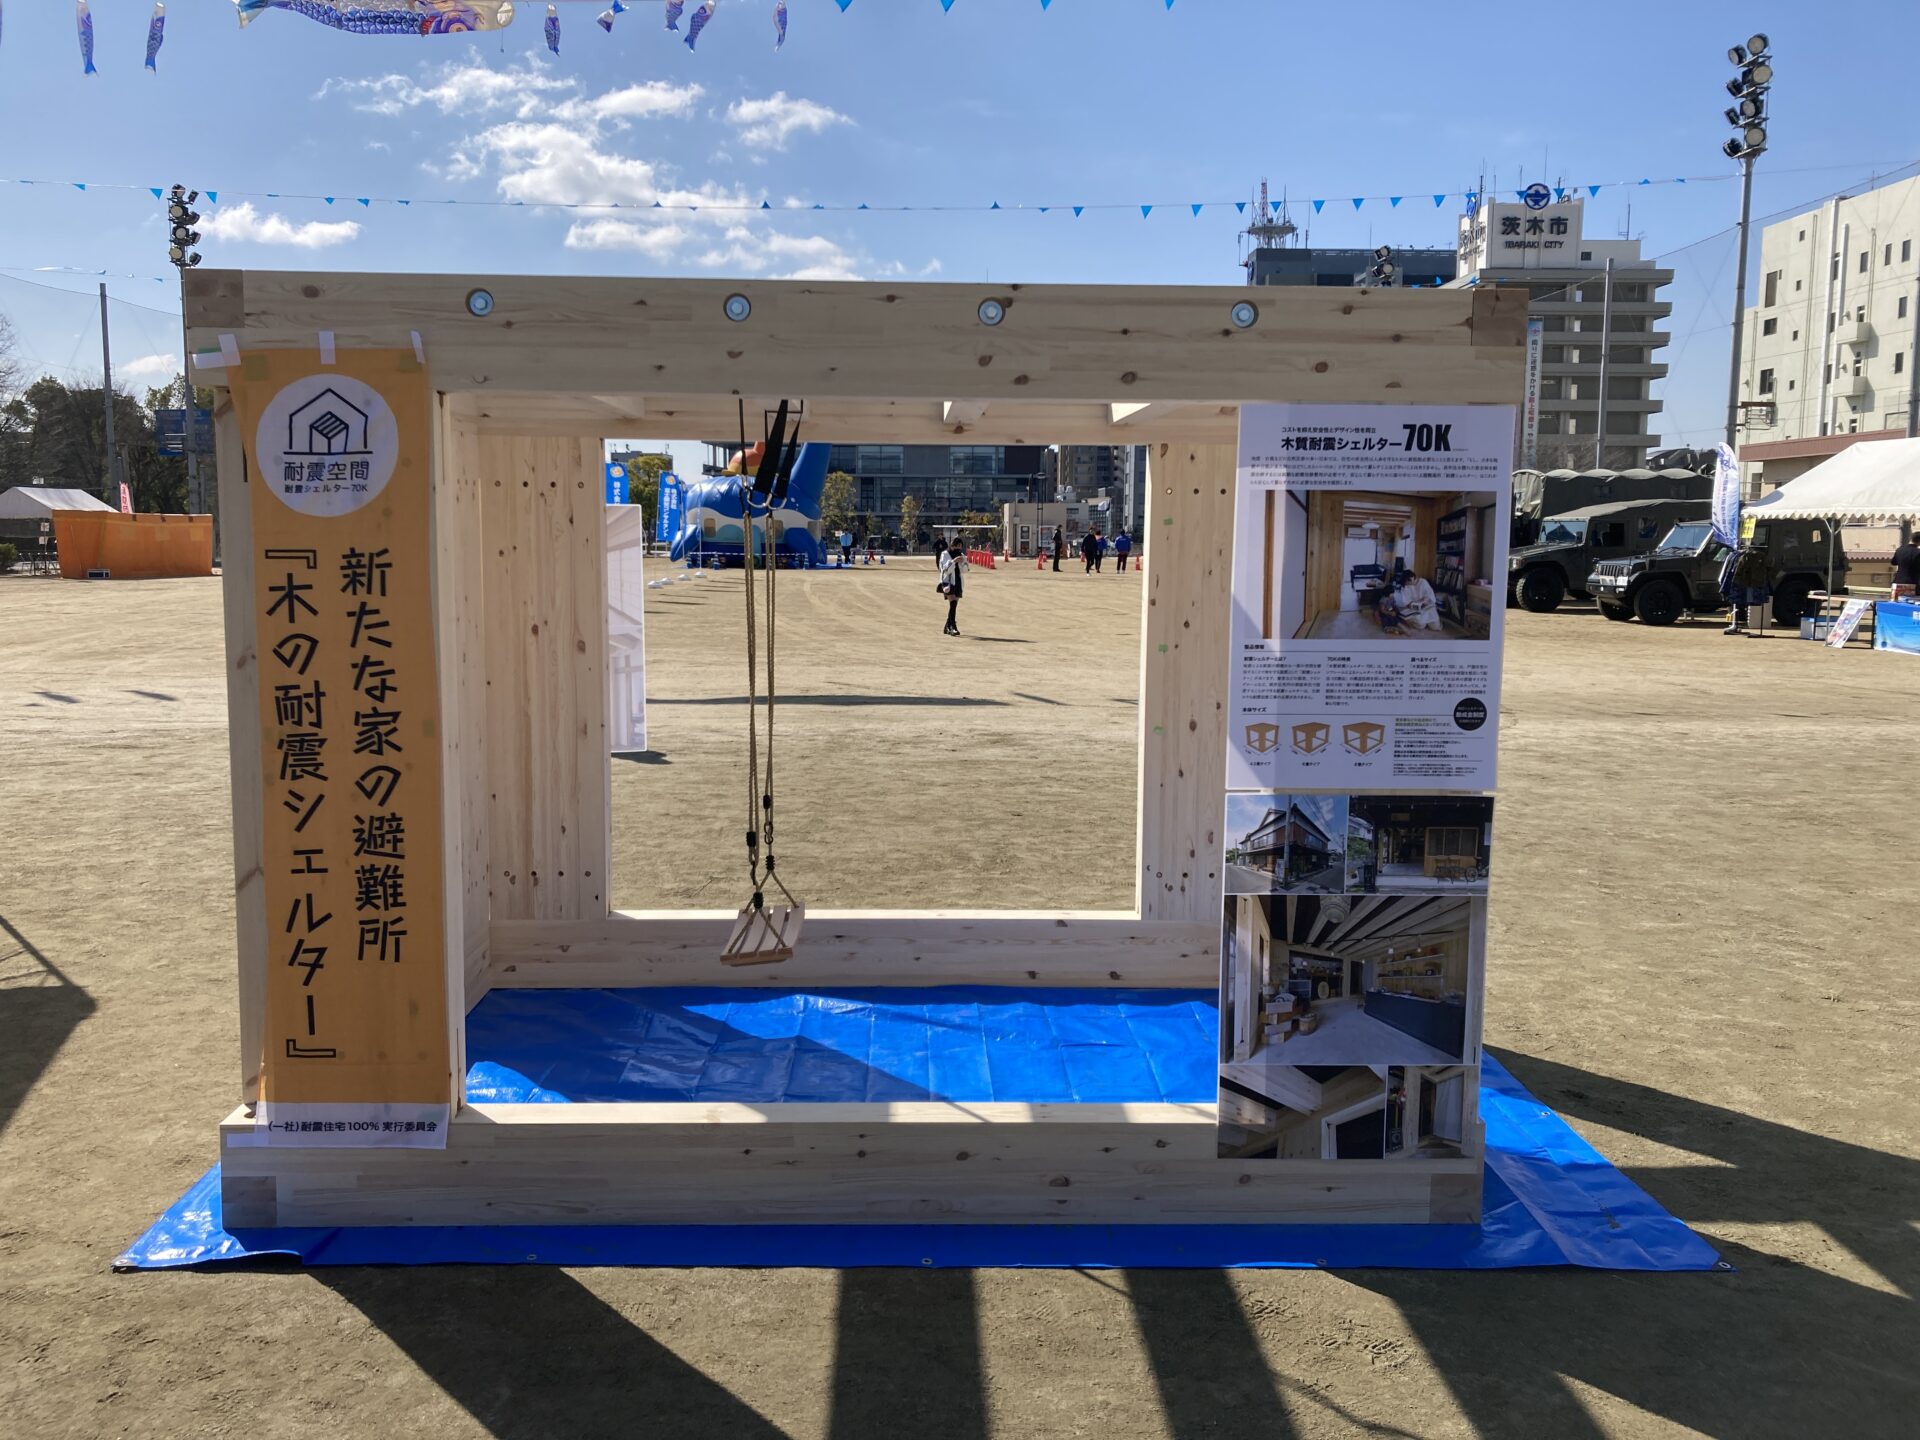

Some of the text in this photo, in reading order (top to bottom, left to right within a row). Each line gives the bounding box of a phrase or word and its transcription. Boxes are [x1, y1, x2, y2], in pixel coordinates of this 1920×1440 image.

[1501, 216, 1569, 236] 茨木市
[1504, 240, 1565, 249] IBARAKI CITY
[1281, 423, 1452, 452] 木質耐震シェルター 70K
[284, 461, 370, 482] 耐震空間
[284, 484, 369, 494] 耐震シェルター70K
[340, 546, 408, 964] 新たな家の避難所
[382, 1121, 438, 1133] 実行委員会
